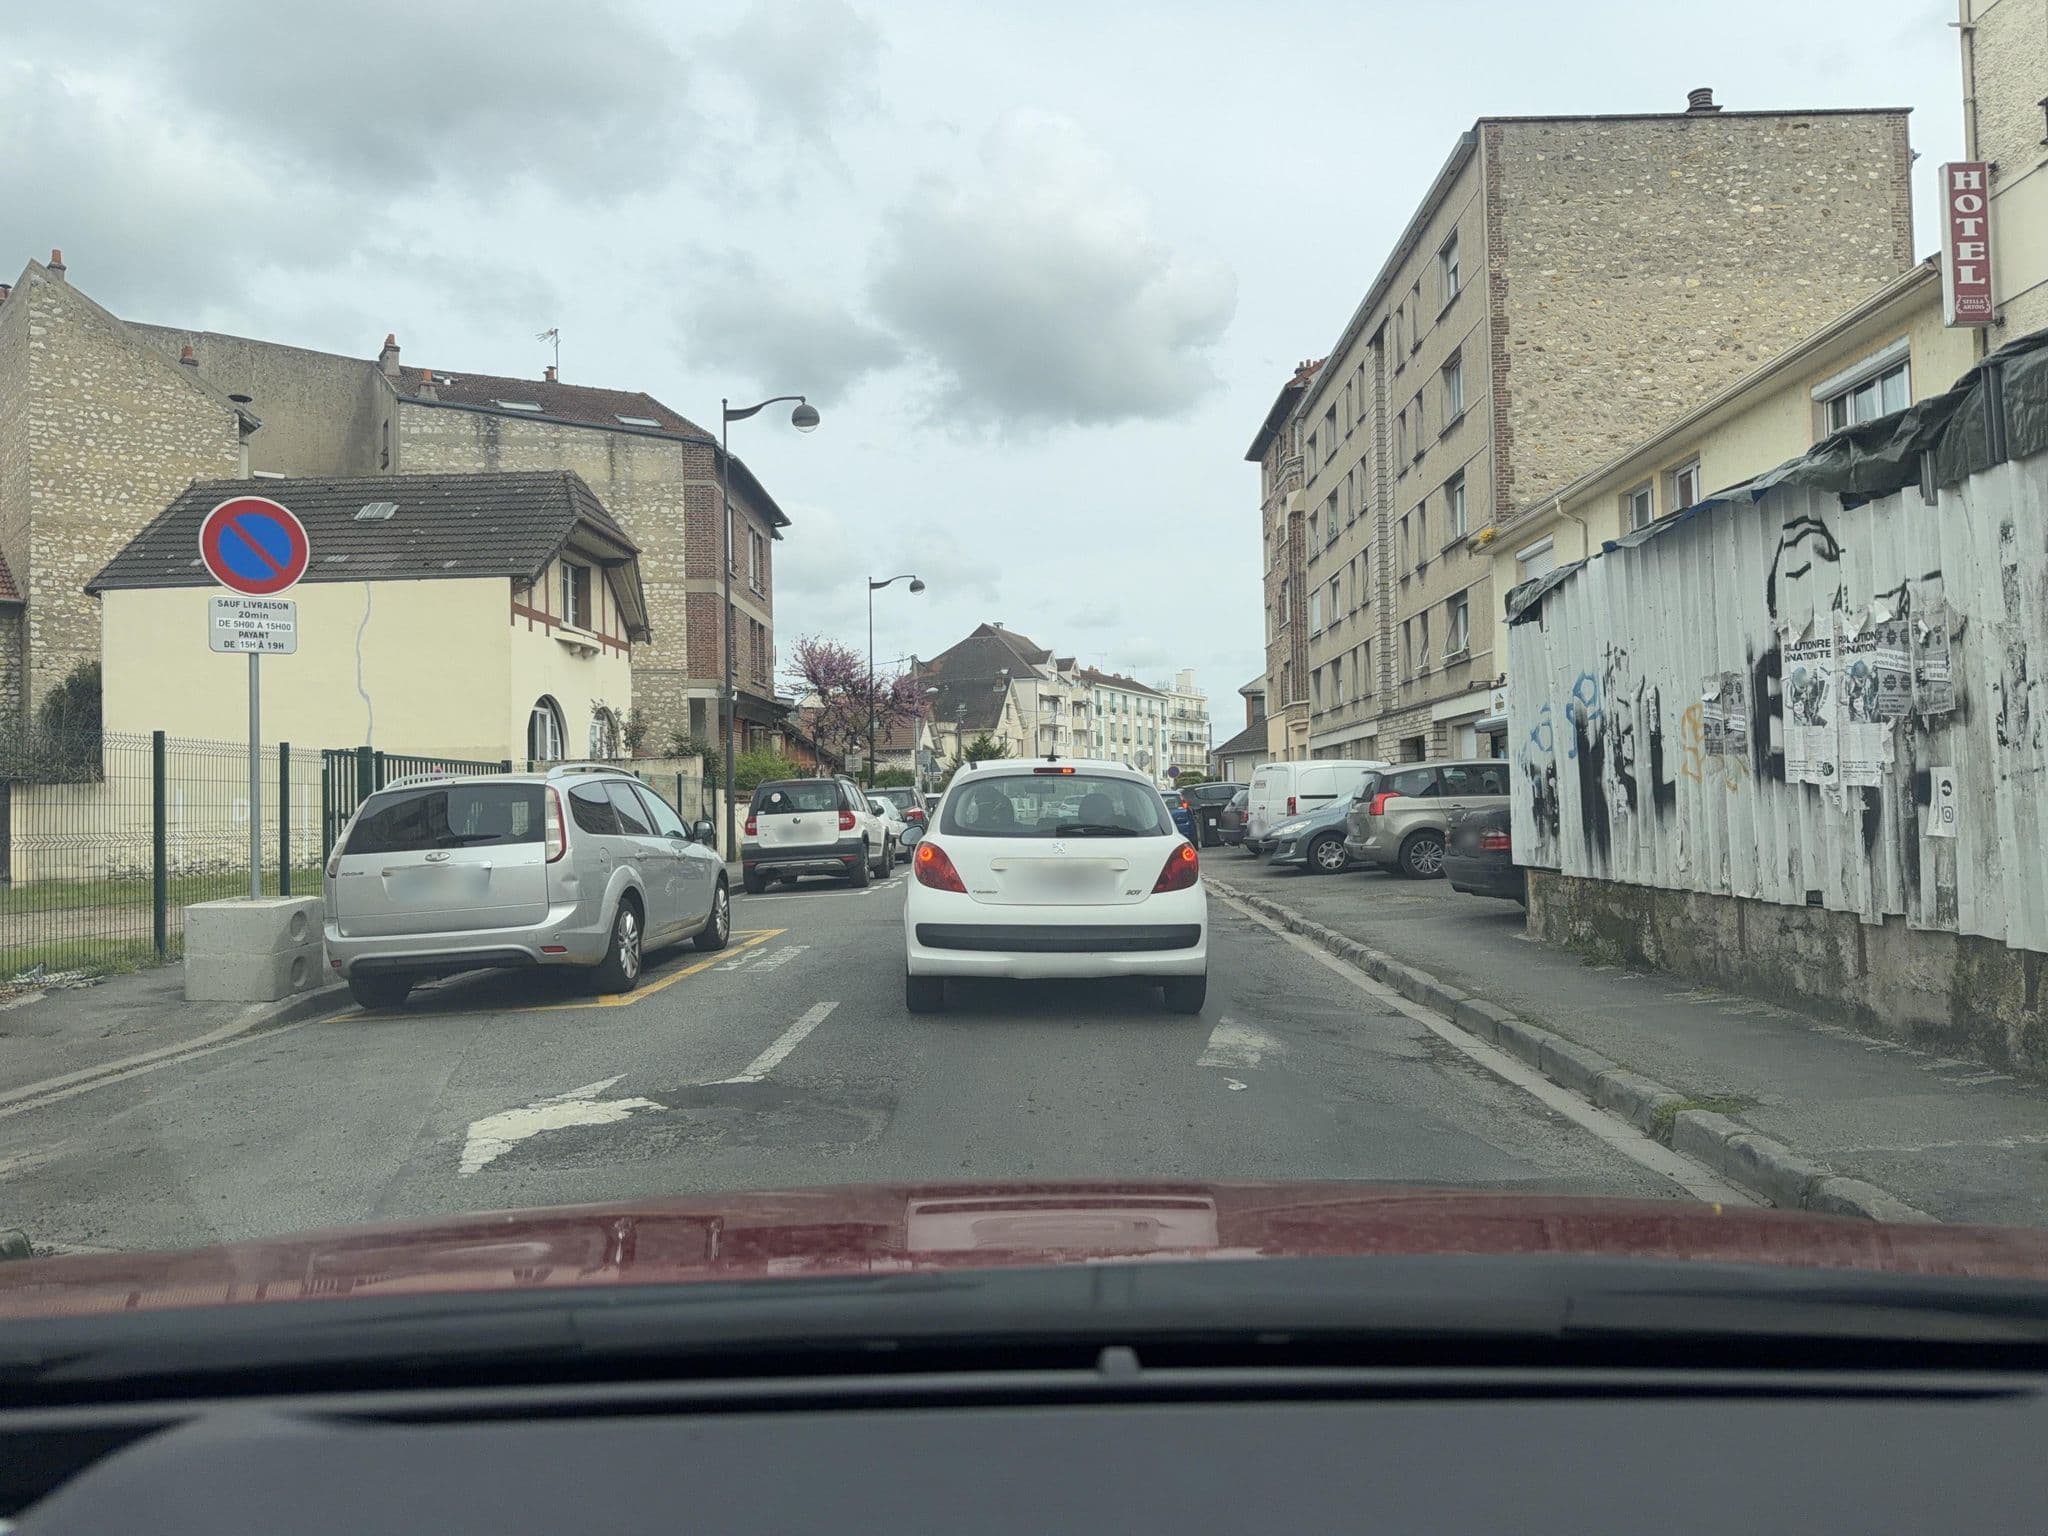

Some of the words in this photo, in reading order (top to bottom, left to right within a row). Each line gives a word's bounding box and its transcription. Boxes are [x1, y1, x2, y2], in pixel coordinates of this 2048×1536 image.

[1953, 171, 1986, 285] HOTEL
[217, 600, 241, 608] SAUF
[243, 601, 289, 610] LIVRAISON
[238, 611, 269, 619] 20min
[218, 620, 231, 628] DE
[233, 621, 255, 629] 5H00
[266, 623, 291, 631] 15H00
[238, 631, 269, 639] PAYANT
[224, 640, 236, 649] DE
[240, 641, 256, 649] 15H
[268, 642, 284, 650] 19H
